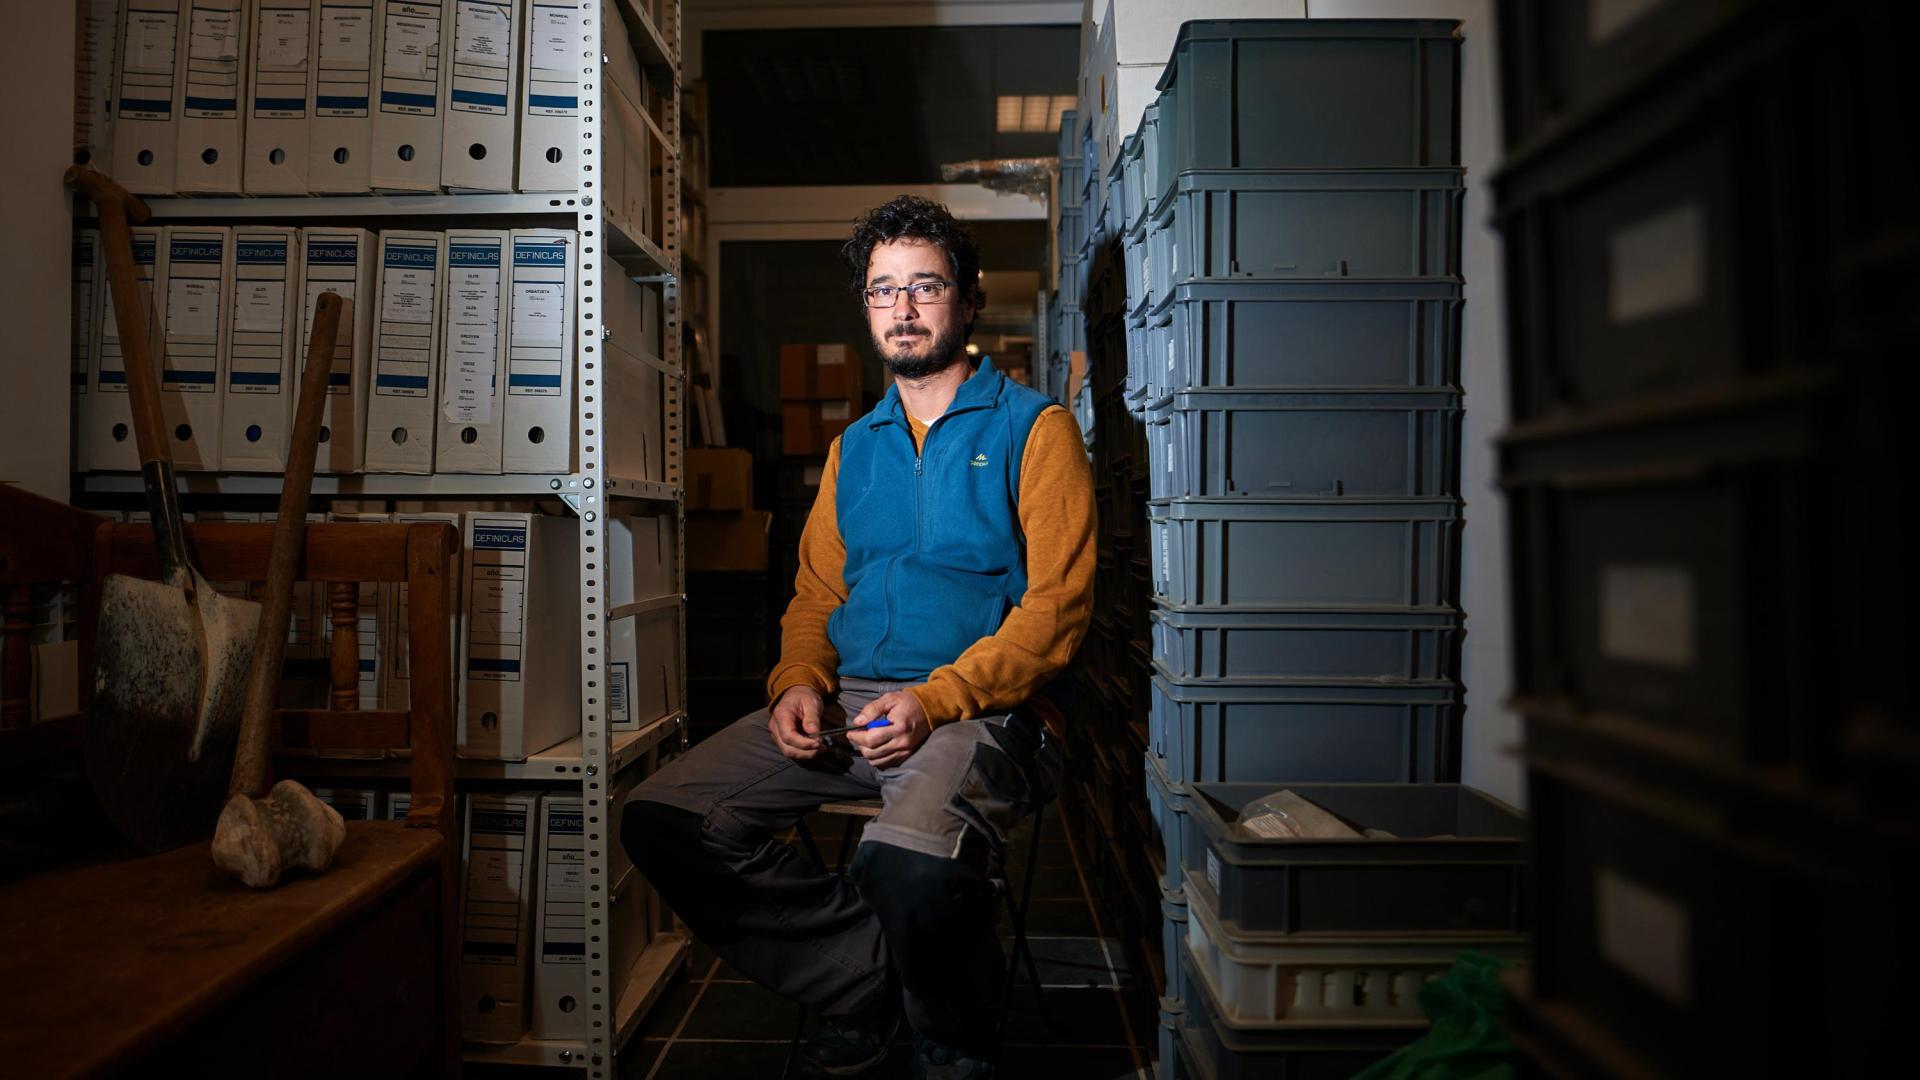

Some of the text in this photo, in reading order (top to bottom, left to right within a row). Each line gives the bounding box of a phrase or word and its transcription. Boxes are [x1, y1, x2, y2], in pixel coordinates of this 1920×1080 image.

[171, 247, 221, 257] DEFINICLAS
[238, 248, 285, 258] DEFINICLAS
[309, 249, 356, 258] DEFINICLAS
[386, 252, 434, 262] DEFINICLAS
[451, 251, 499, 260] DEFINICLAS
[515, 251, 564, 260] DEFINICLAS
[475, 534, 525, 544] DEFINICLAS
